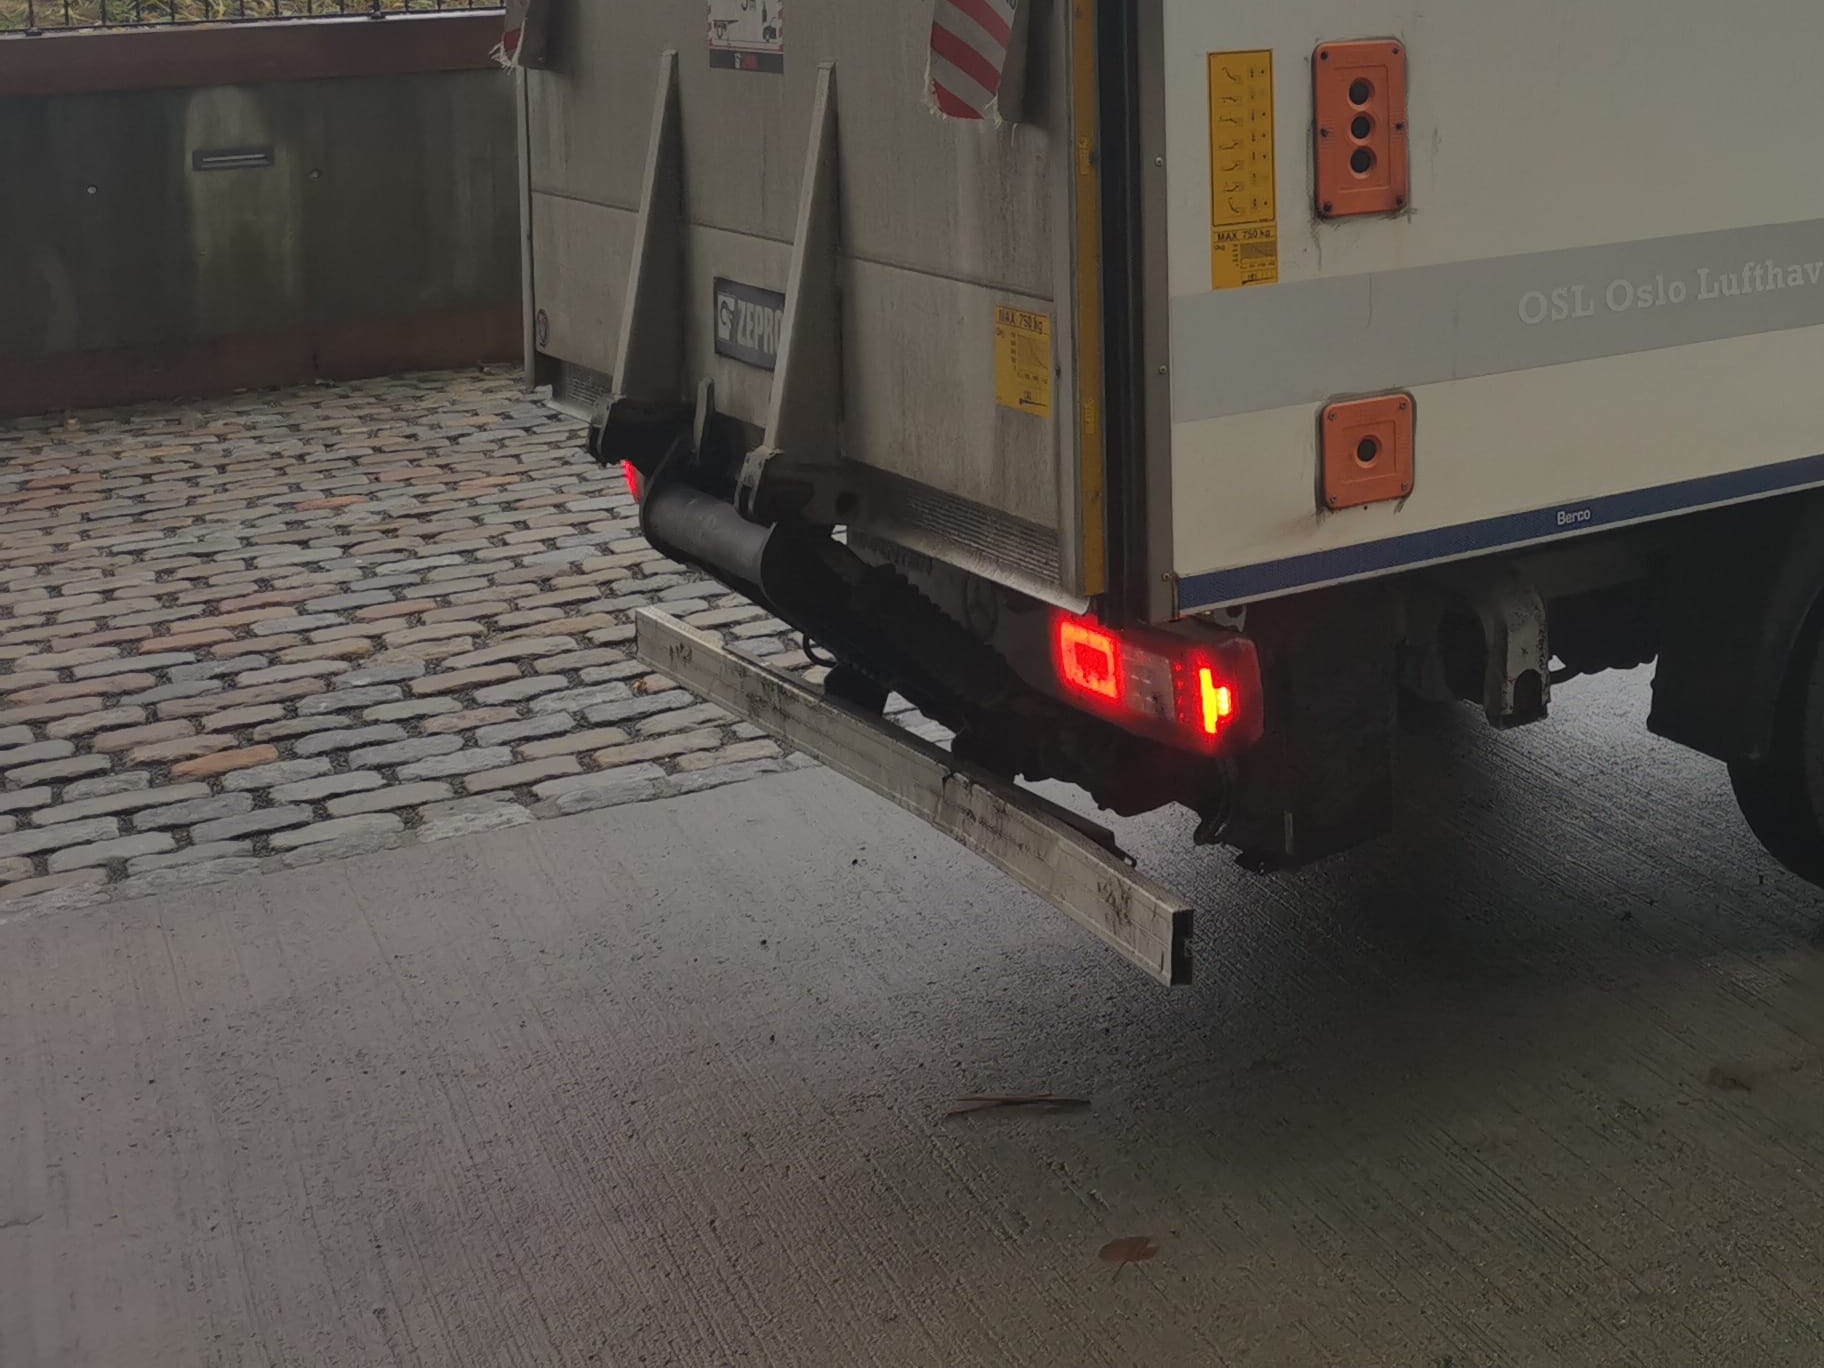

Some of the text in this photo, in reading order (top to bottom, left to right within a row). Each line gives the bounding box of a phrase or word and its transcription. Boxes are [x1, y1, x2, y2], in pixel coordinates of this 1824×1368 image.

[1518, 284, 1595, 325] OSL
[1605, 274, 1687, 312] Oslo
[1556, 508, 1591, 526] Berco
